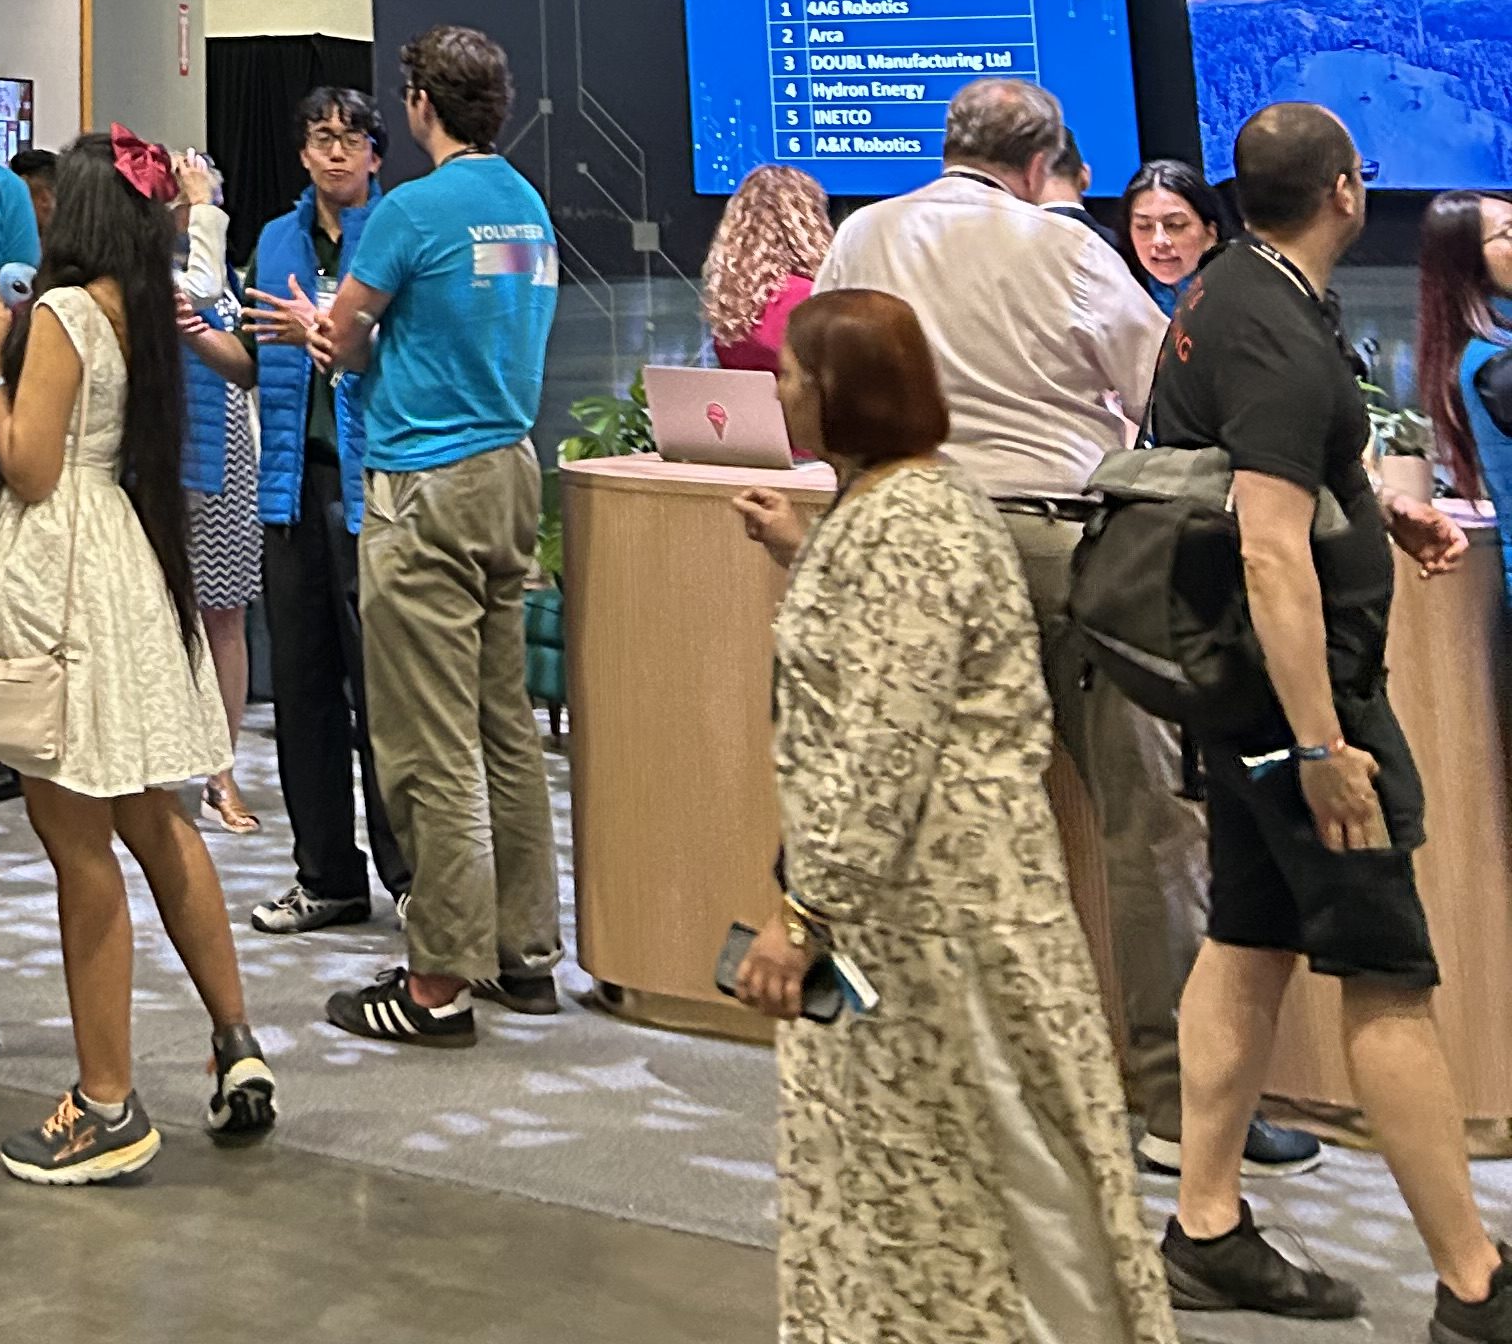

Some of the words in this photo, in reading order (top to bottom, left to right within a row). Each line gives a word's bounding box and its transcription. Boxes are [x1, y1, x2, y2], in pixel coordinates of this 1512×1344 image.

[780, 2, 792, 17] 1
[807, 0, 840, 16] 4AG
[842, 0, 909, 15] Robotics
[781, 28, 794, 44] 2
[809, 28, 845, 43] Arca
[783, 56, 795, 71] 3
[810, 54, 867, 71] DOUBL
[867, 52, 983, 71] Manufacturing
[986, 51, 1012, 68] Ltd
[784, 82, 797, 98] 4
[812, 82, 869, 100] Hydron
[871, 82, 926, 100] Energy
[787, 110, 799, 126] 5
[814, 109, 872, 125] INETCO
[789, 137, 801, 153] 6
[816, 137, 852, 153] A&K
[853, 137, 922, 153] Robotics
[468, 224, 546, 242] VOLUNTEER
